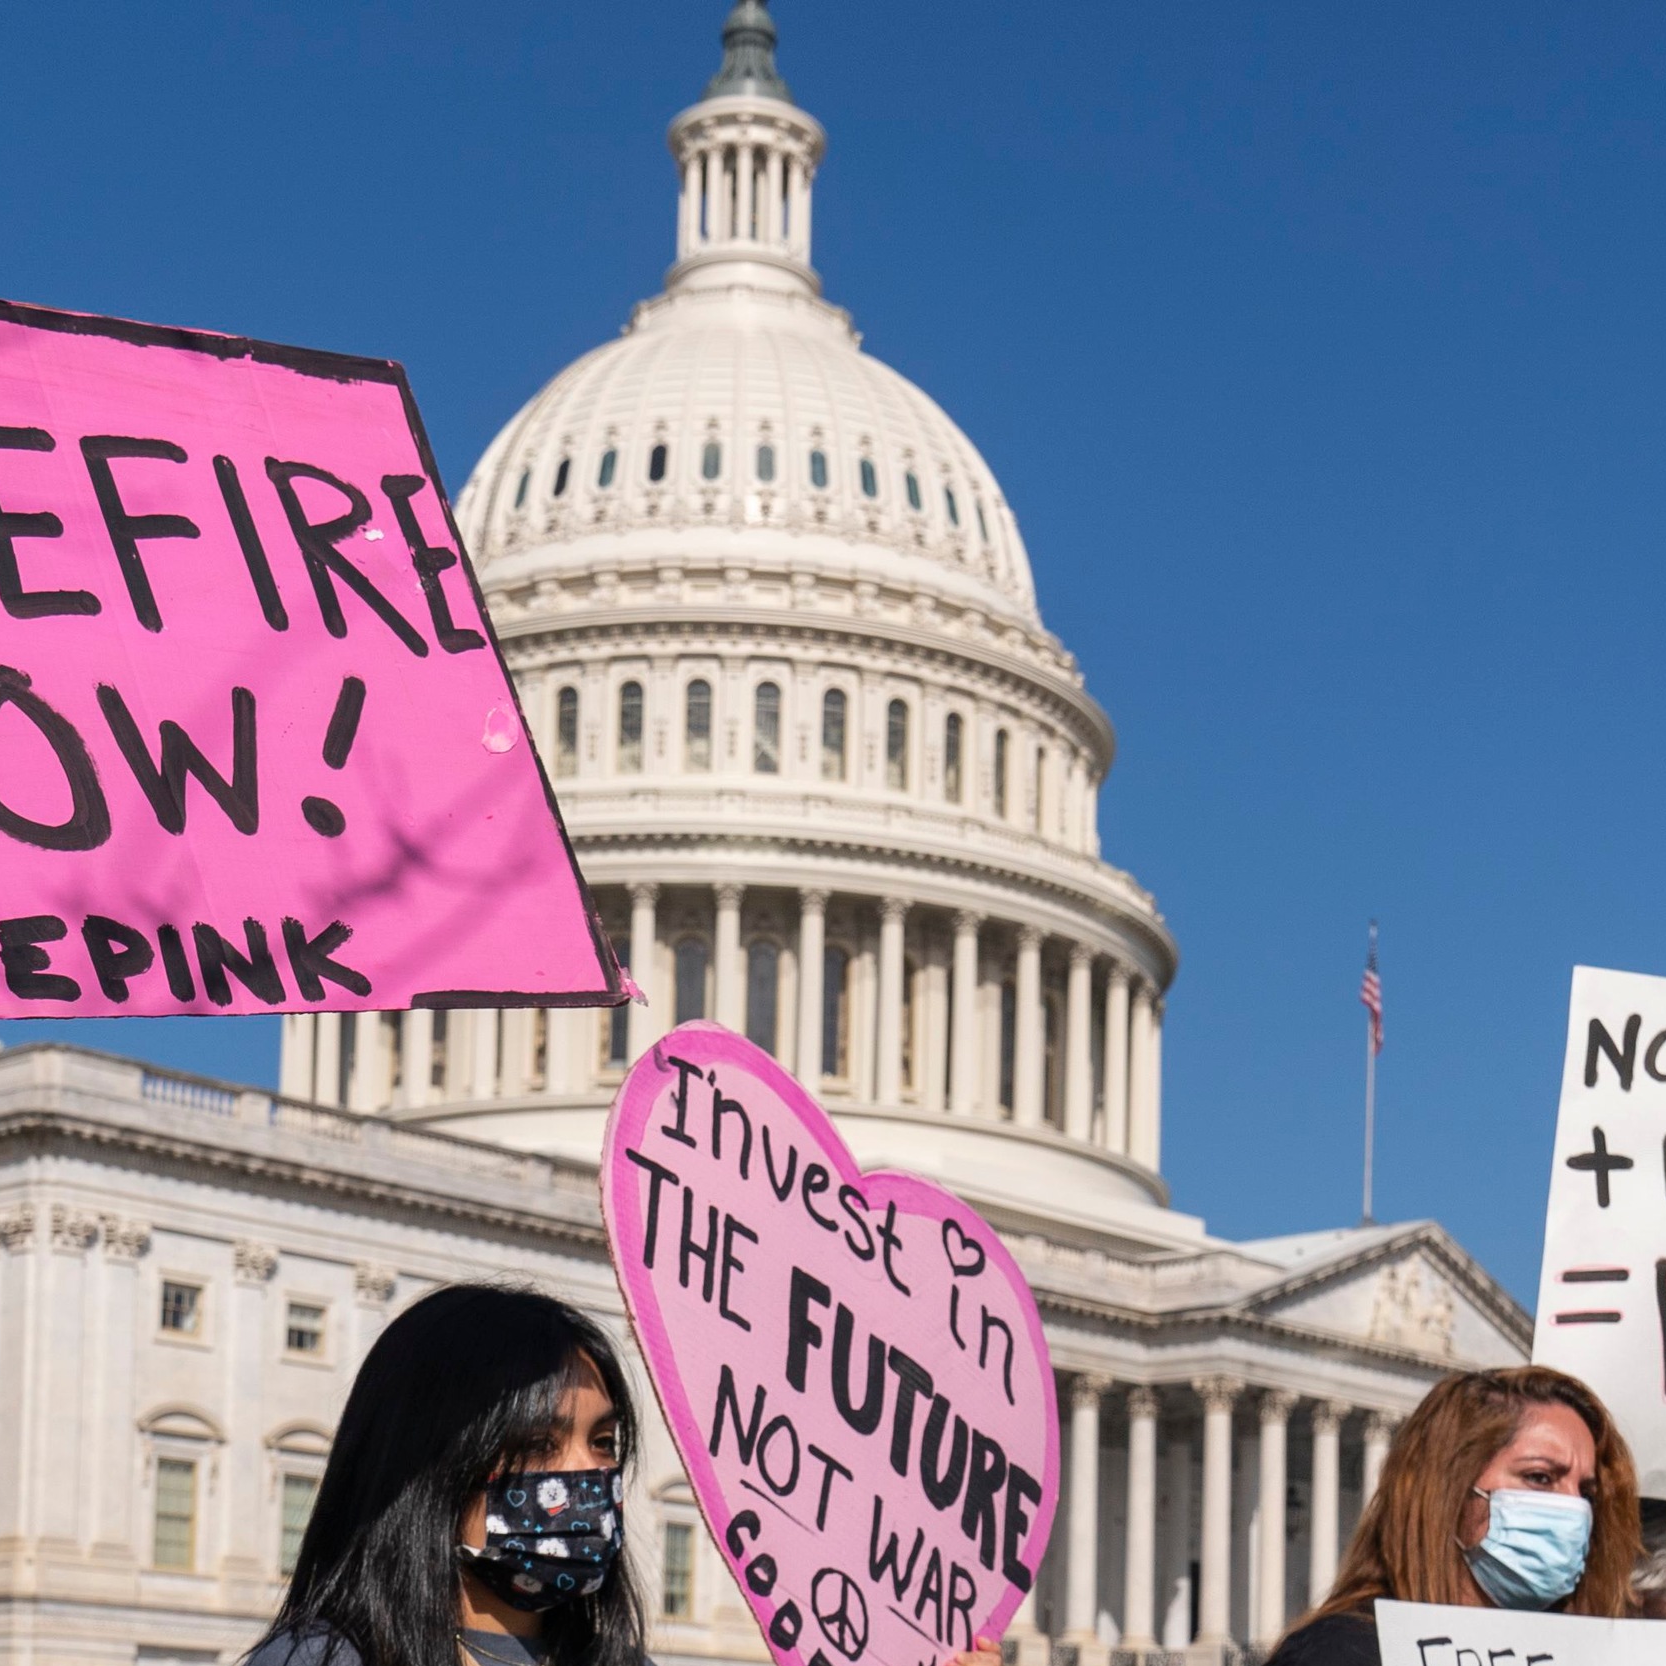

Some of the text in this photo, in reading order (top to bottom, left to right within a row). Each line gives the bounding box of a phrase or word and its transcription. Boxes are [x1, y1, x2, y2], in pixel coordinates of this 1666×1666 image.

[625, 1148, 1043, 1594] THE FUTURE
[709, 1365, 978, 1652] NOT WAR
